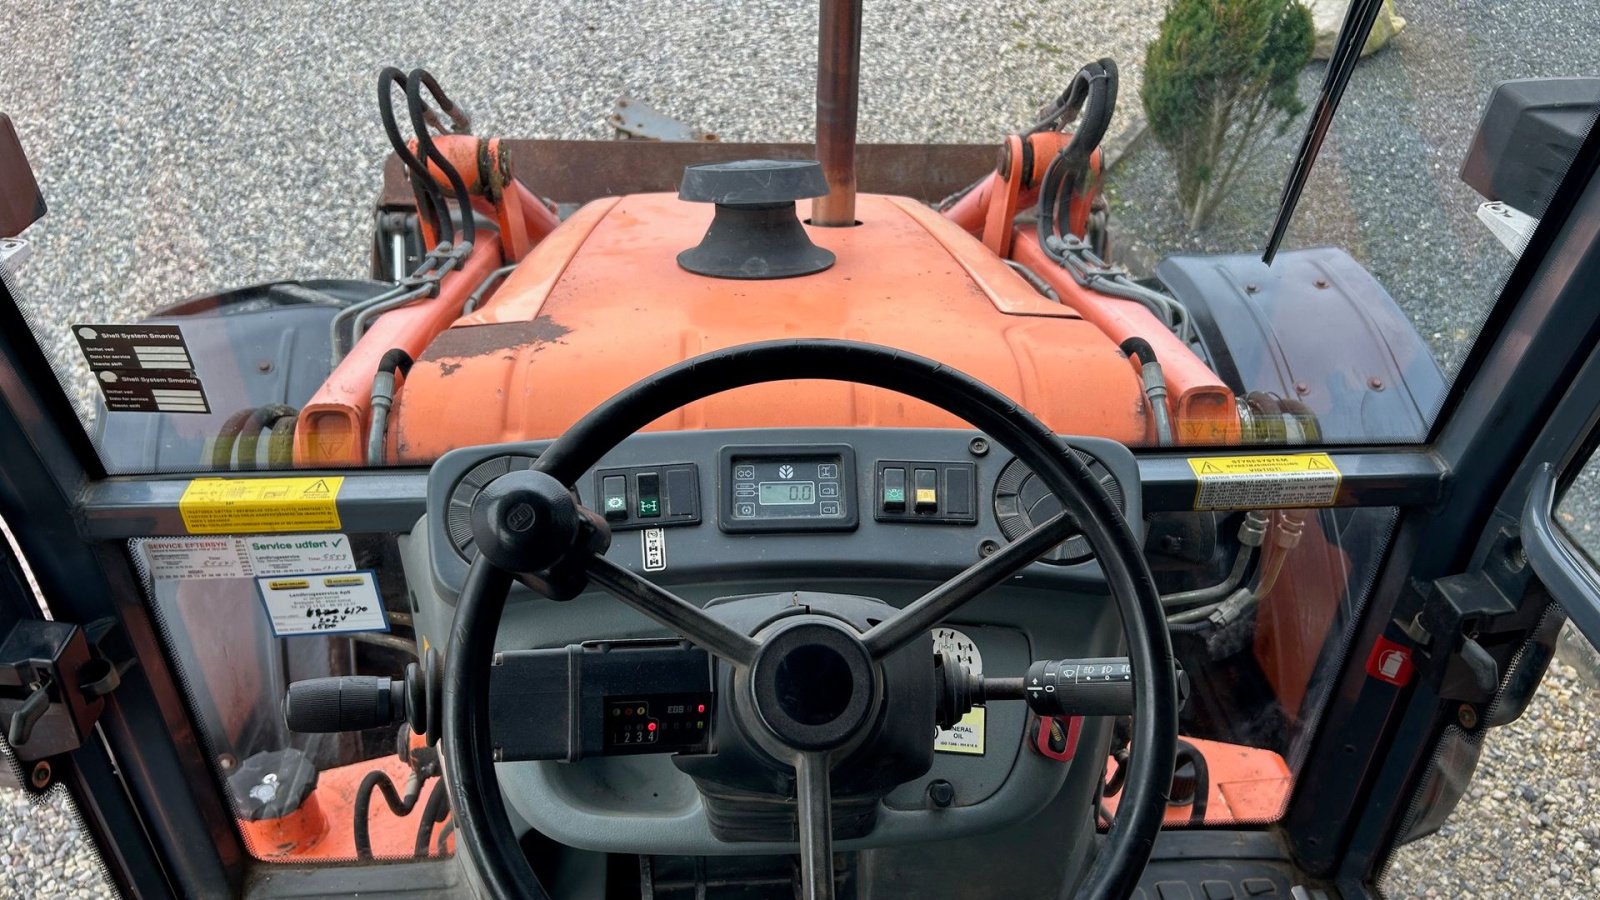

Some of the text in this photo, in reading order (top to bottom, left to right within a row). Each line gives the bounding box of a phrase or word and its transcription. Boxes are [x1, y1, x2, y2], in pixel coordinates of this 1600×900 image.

[789, 485, 812, 501] 0.0
[147, 541, 227, 550] SERVICE EFTERSYN
[252, 540, 328, 551] Service udført
[624, 732, 630, 743] 2
[636, 731, 643, 742] 3
[648, 731, 654, 742] 4
